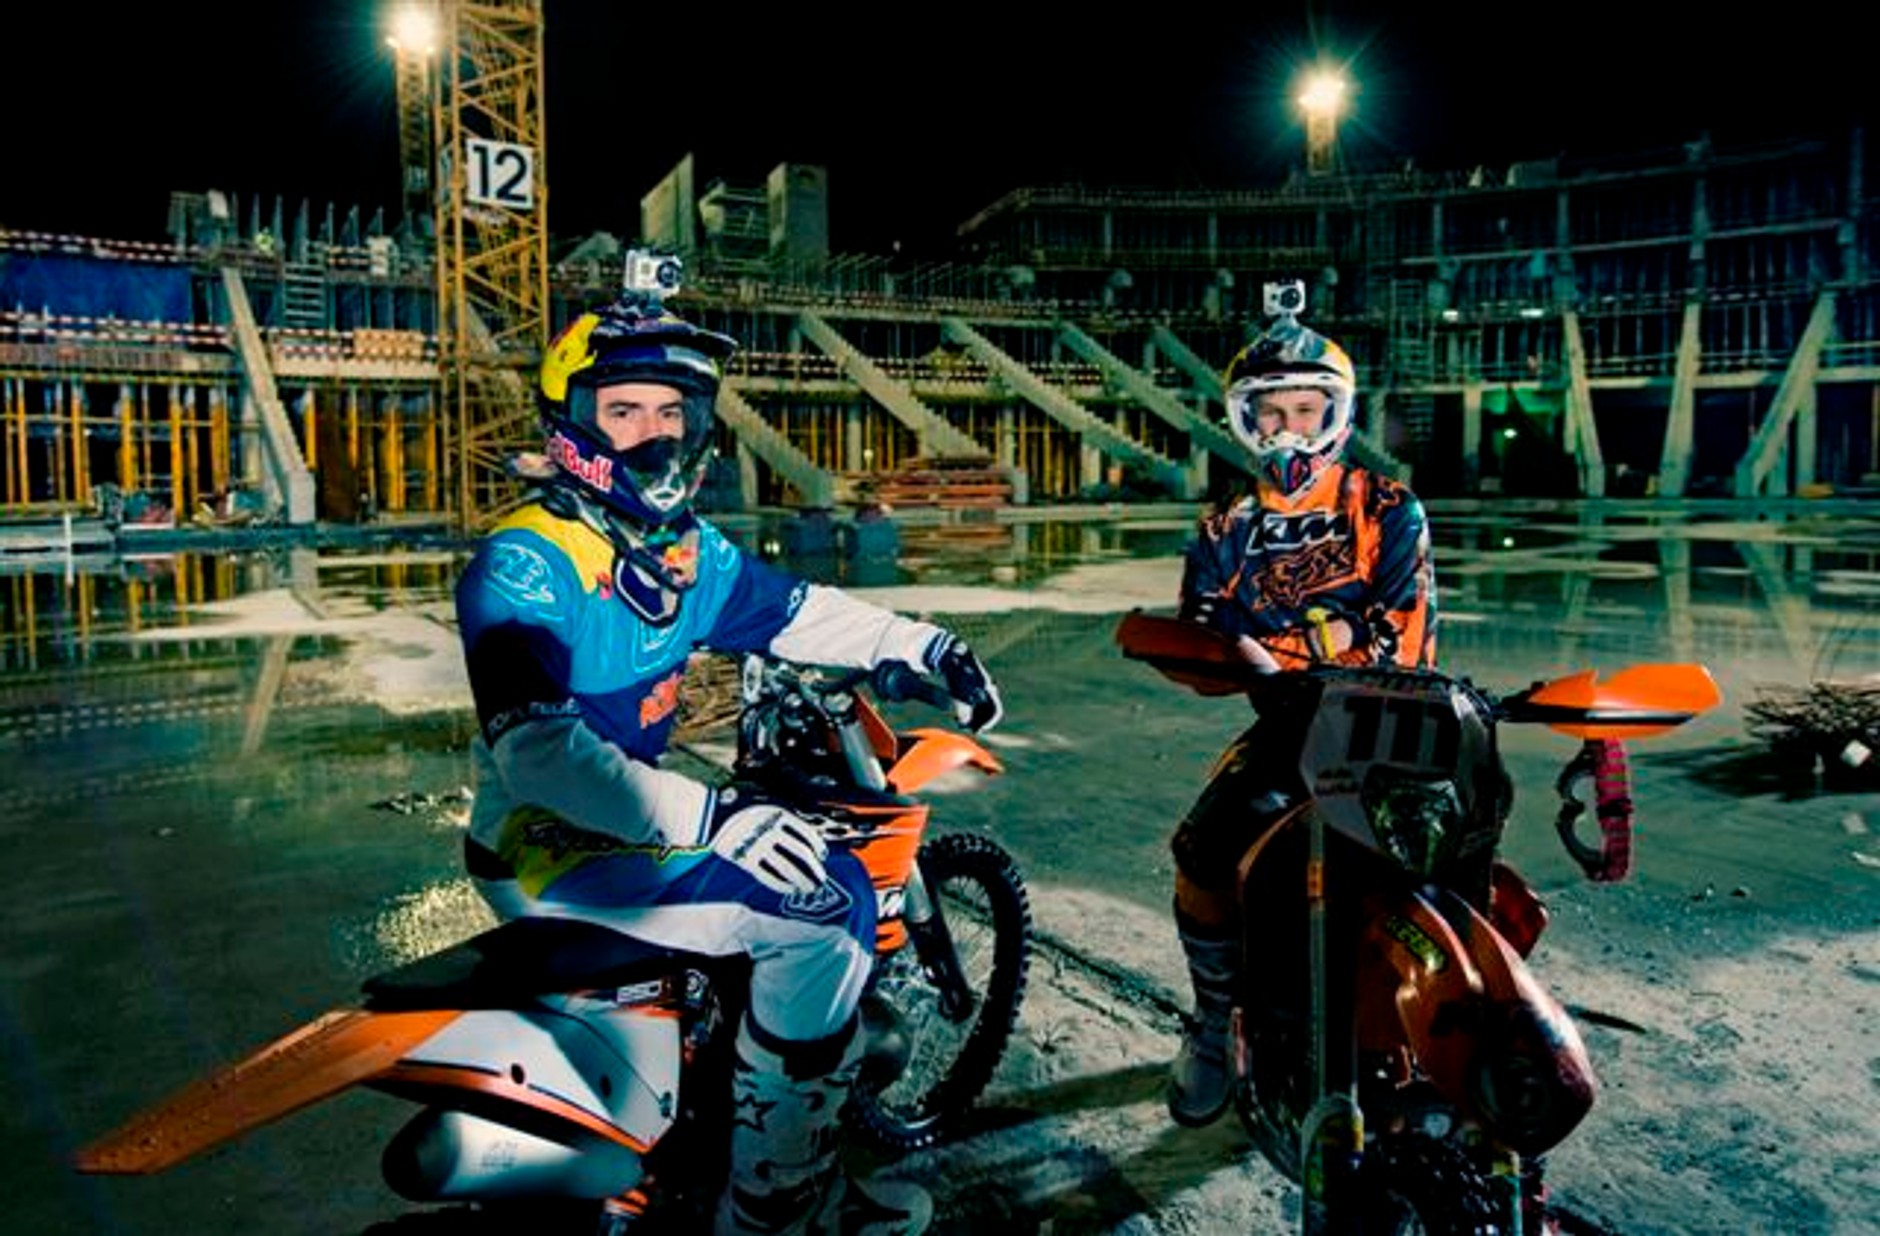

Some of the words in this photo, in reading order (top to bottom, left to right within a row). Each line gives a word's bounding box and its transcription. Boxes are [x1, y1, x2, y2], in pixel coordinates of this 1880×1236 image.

[473, 145, 527, 203] 12
[1245, 510, 1350, 556] KTM
[1344, 697, 1460, 773] 111
